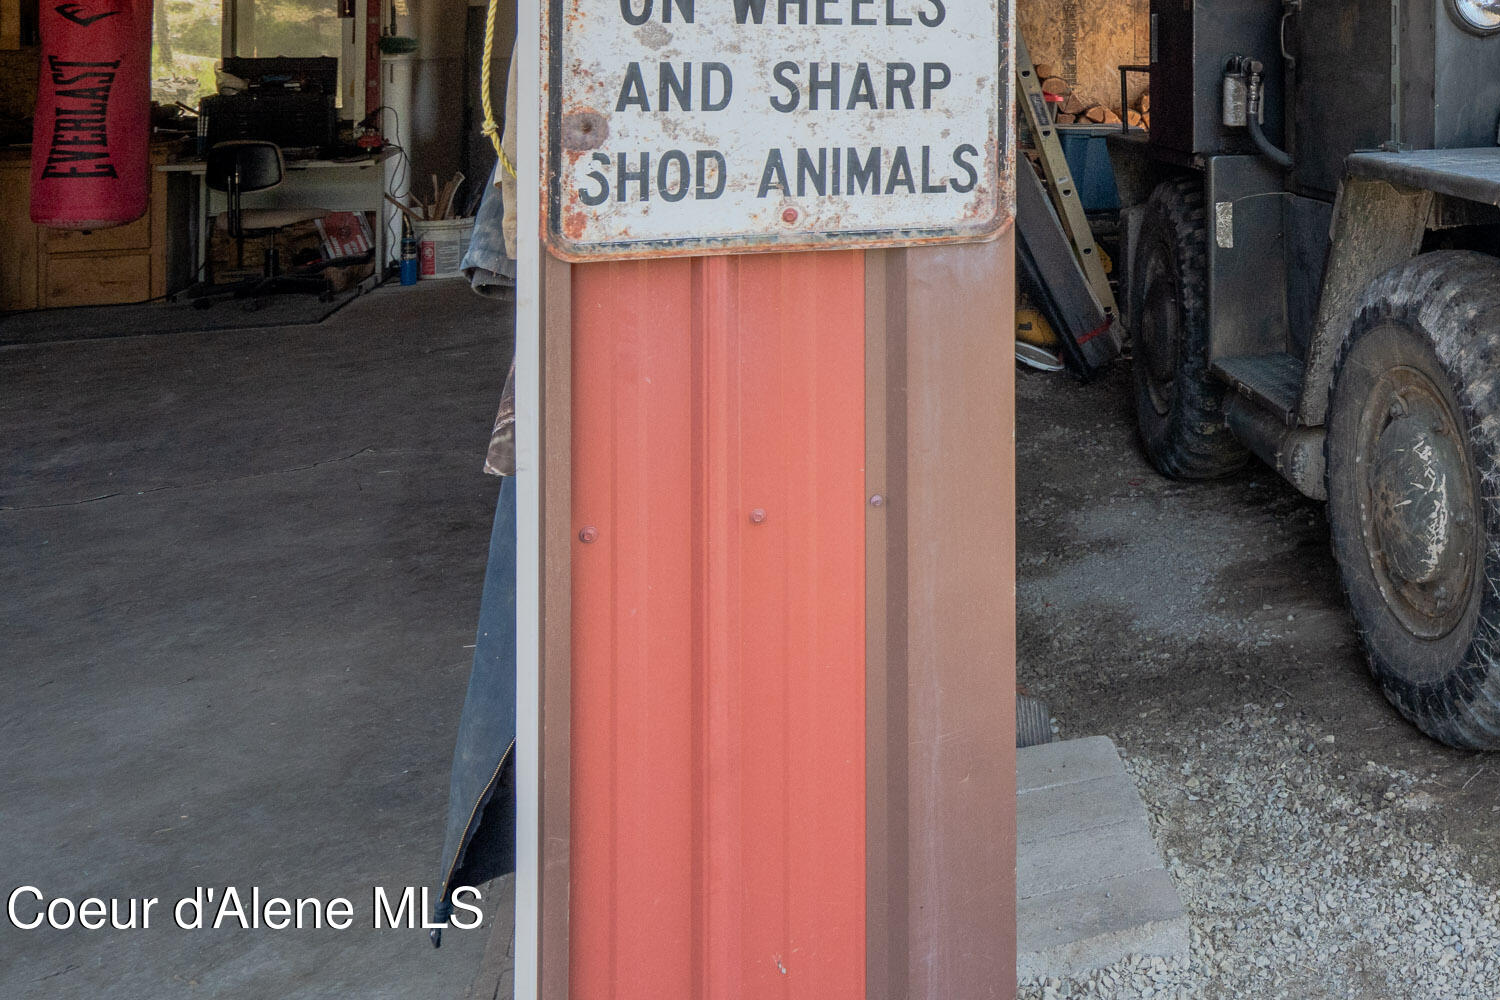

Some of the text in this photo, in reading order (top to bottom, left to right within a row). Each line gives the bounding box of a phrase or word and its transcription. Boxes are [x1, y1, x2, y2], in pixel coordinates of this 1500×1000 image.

[41, 54, 120, 180] EVERLAST
[615, 61, 951, 114] AND SHARP
[578, 143, 978, 206] SHOD ANIMALS
